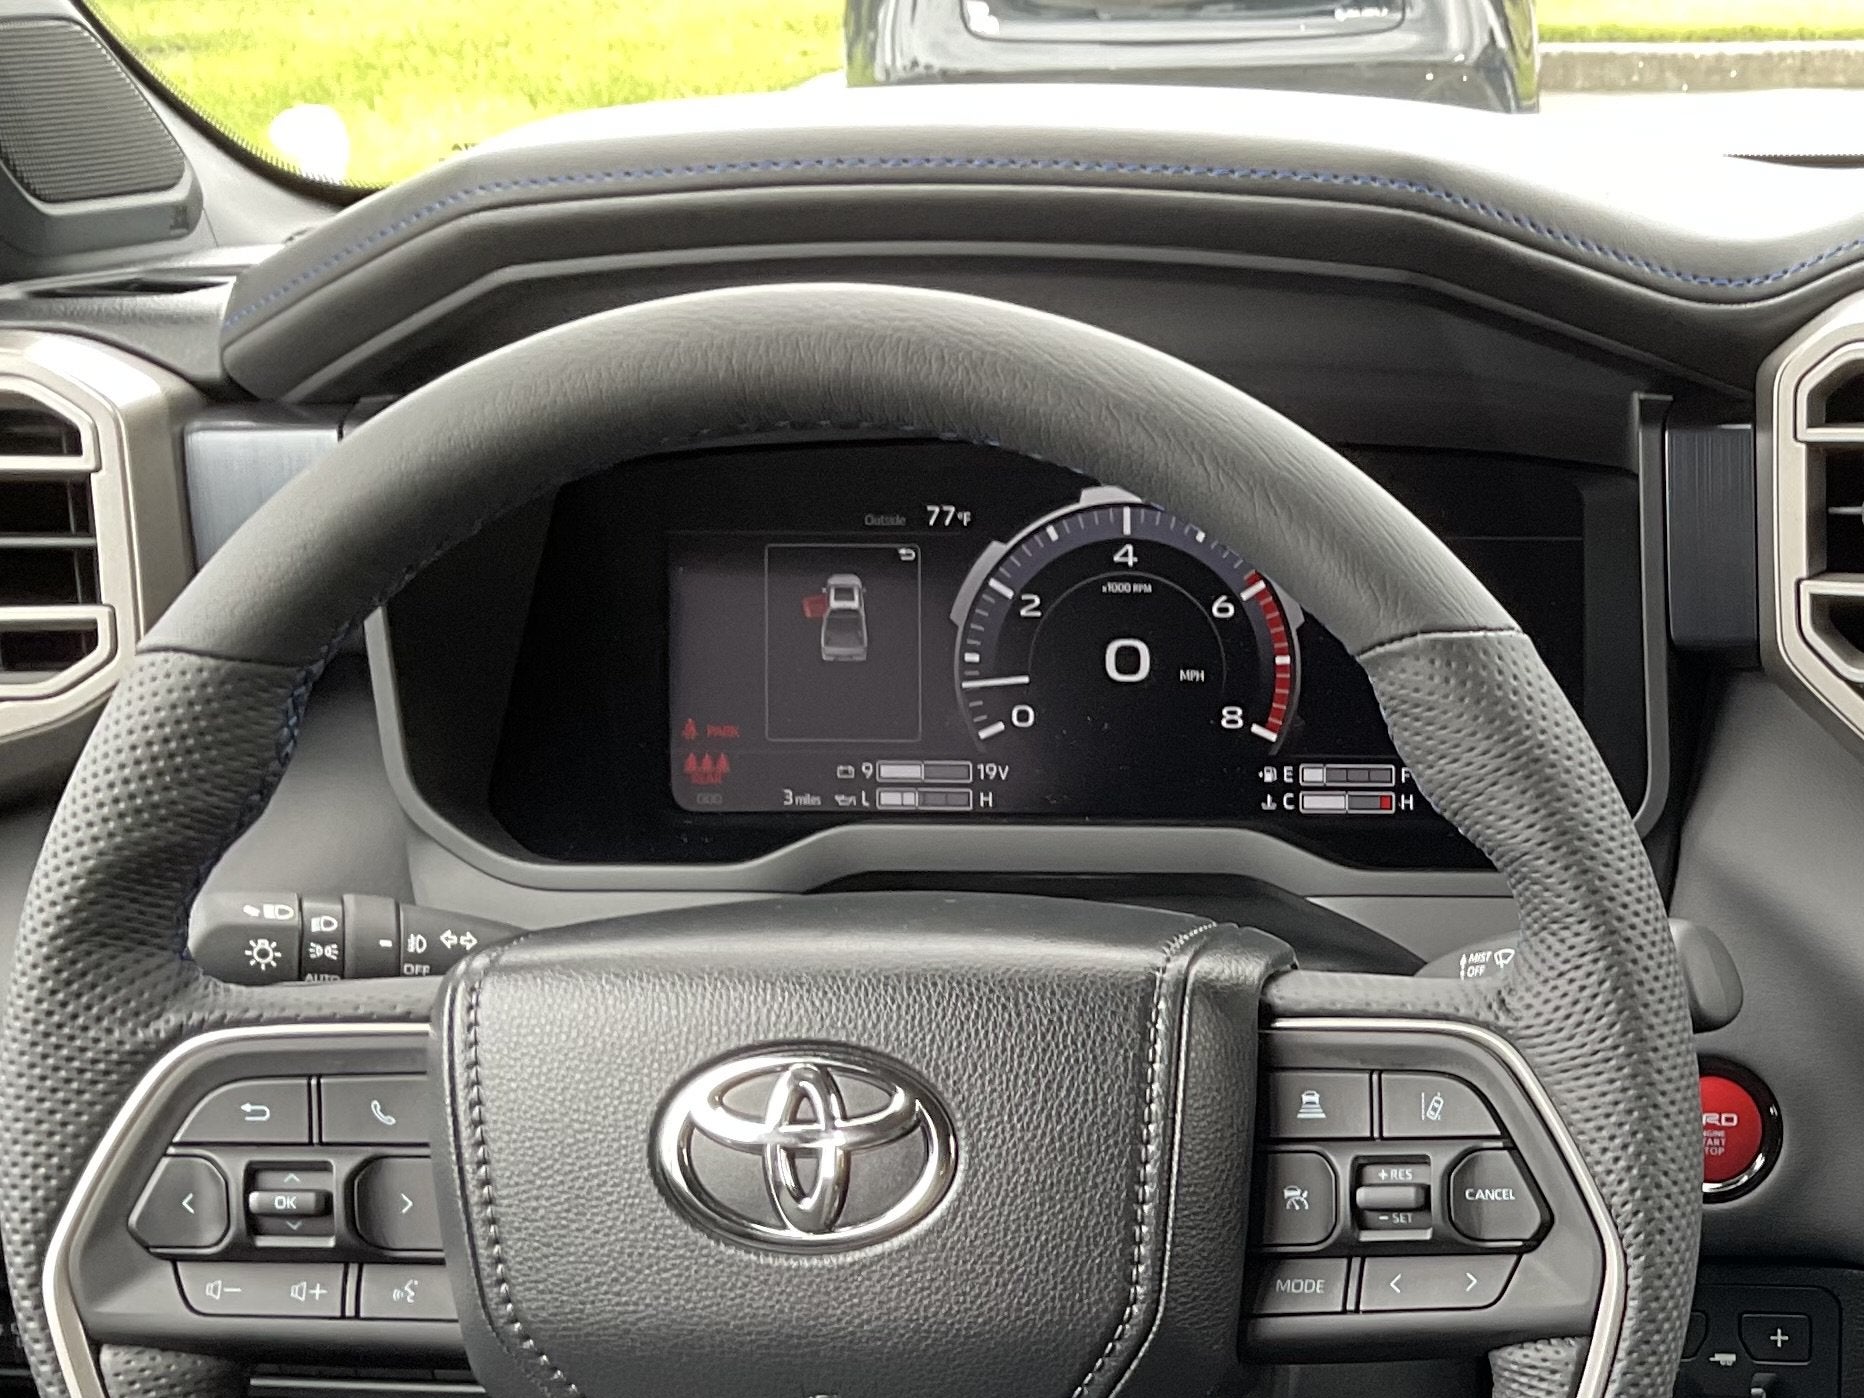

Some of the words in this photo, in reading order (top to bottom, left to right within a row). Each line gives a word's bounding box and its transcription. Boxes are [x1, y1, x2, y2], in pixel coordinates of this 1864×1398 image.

[864, 514, 906, 527] Outside
[1112, 543, 1139, 567] 4
[1132, 583, 1153, 594] RPM
[1019, 594, 1042, 617] 2
[1211, 595, 1235, 618] 6
[1105, 638, 1150, 682] 0
[1179, 669, 1205, 682] MPH
[1011, 704, 1036, 728] 0
[1220, 706, 1244, 729] 8
[861, 762, 874, 779] 9
[977, 762, 1010, 780] 19V
[1283, 765, 1294, 783] E
[795, 793, 822, 806] miles
[861, 791, 870, 807] L
[979, 792, 993, 808] H
[1283, 792, 1295, 810] C
[1401, 794, 1414, 810] H
[1468, 950, 1492, 964] MIST
[403, 963, 430, 976] OFF
[1467, 964, 1486, 978] OFF
[1702, 1112, 1738, 1127] RD
[1704, 1146, 1725, 1156] TOP
[274, 1195, 297, 1210] OK
[1464, 1188, 1516, 1202] CANCEL
[1275, 1279, 1326, 1294] MODE
